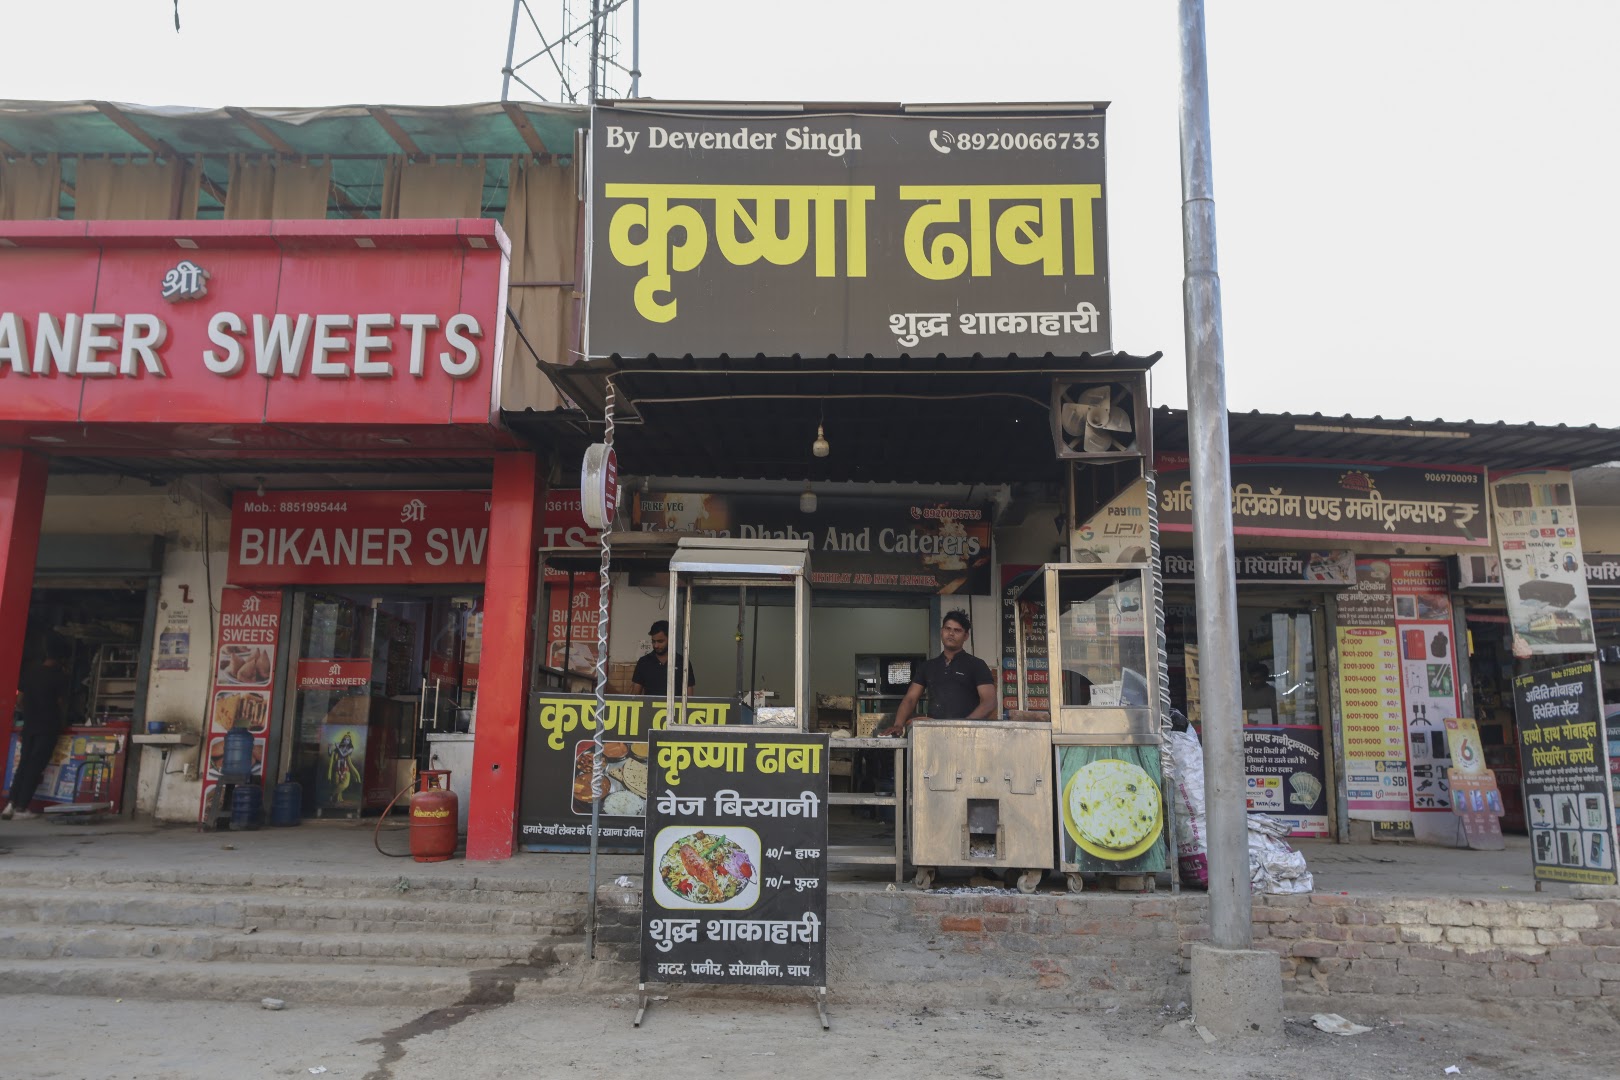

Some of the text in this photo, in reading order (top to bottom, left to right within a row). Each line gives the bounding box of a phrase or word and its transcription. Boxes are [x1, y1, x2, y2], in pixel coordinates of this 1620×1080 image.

[606, 126, 862, 157] By Devender Singh
[956, 131, 1101, 152] 8920066733
[605, 183, 1101, 323] कृष्णा ढाबा
[162, 260, 208, 300] श्री
[889, 302, 1100, 347] शुद्ध शाकाहारी
[203, 311, 483, 379] SWEETS
[1424, 473, 1478, 484] 9069700093
[280, 502, 347, 513] 8851995444
[400, 498, 427, 523] श्री
[667, 502, 684, 512] VEG
[1304, 496, 1342, 521] एण्ड
[239, 528, 413, 566] BIKANER
[822, 527, 981, 555] And Caterers
[242, 595, 261, 613] श्री
[222, 613, 277, 627] BIKANER
[223, 629, 274, 642] SWEETS
[301, 677, 366, 685] BIKANER SWEETS
[1526, 684, 1550, 702] अदिति
[1550, 681, 1583, 698] मोबाइल
[540, 698, 643, 751] कृष्णा
[1543, 726, 1560, 744] हाथ
[1561, 719, 1597, 741] मोबाइल
[657, 741, 823, 785] कृष्णा ढाबा
[1392, 776, 1407, 787] SBI
[657, 789, 820, 818] वेज बिरयानी
[577, 824, 586, 835] के
[795, 847, 820, 859] हाफ
[794, 878, 819, 892] फुल
[650, 912, 821, 952] शुद्ध शाकाहारी
[788, 964, 810, 977] चाप
